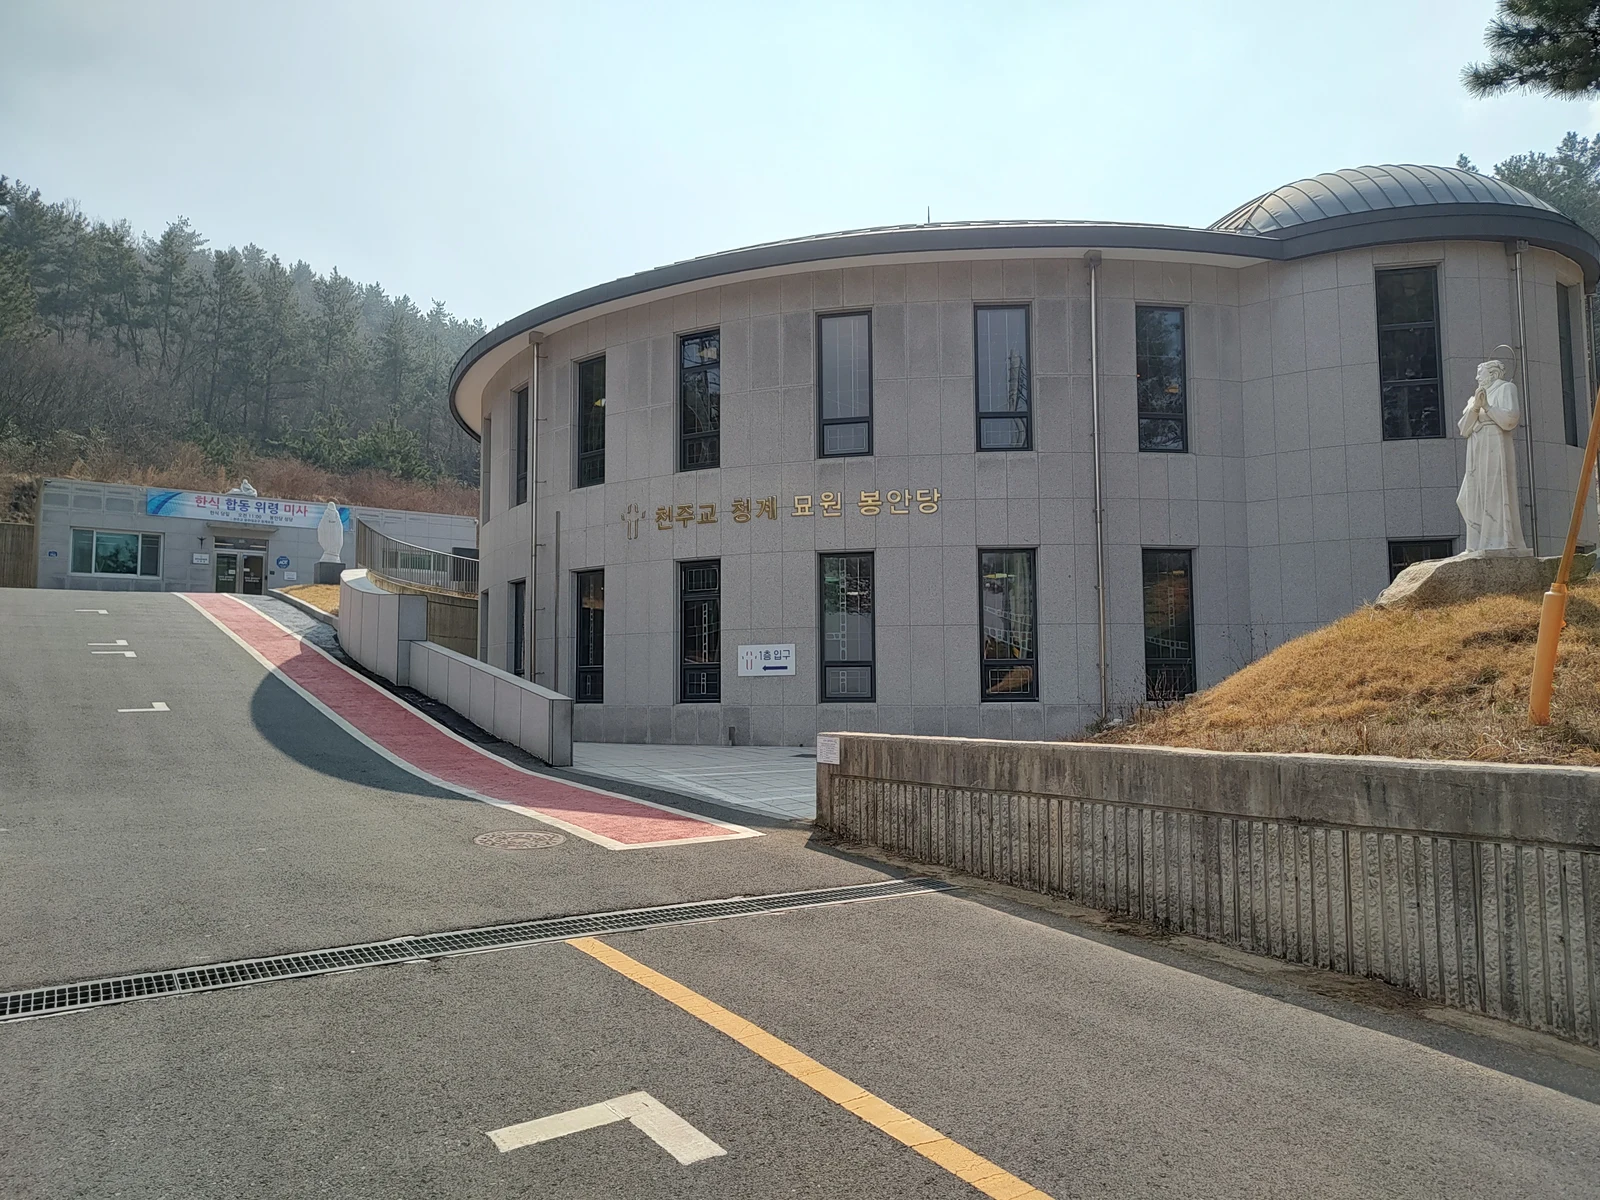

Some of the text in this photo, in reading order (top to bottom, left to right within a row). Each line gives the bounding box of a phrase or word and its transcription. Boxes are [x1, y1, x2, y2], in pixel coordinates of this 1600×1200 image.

[195, 495, 308, 517] 한식 합동 위령 미사
[655, 487, 942, 530] 천주교 청계 묘원 봉안당
[759, 649, 791, 661] 1층 입구
